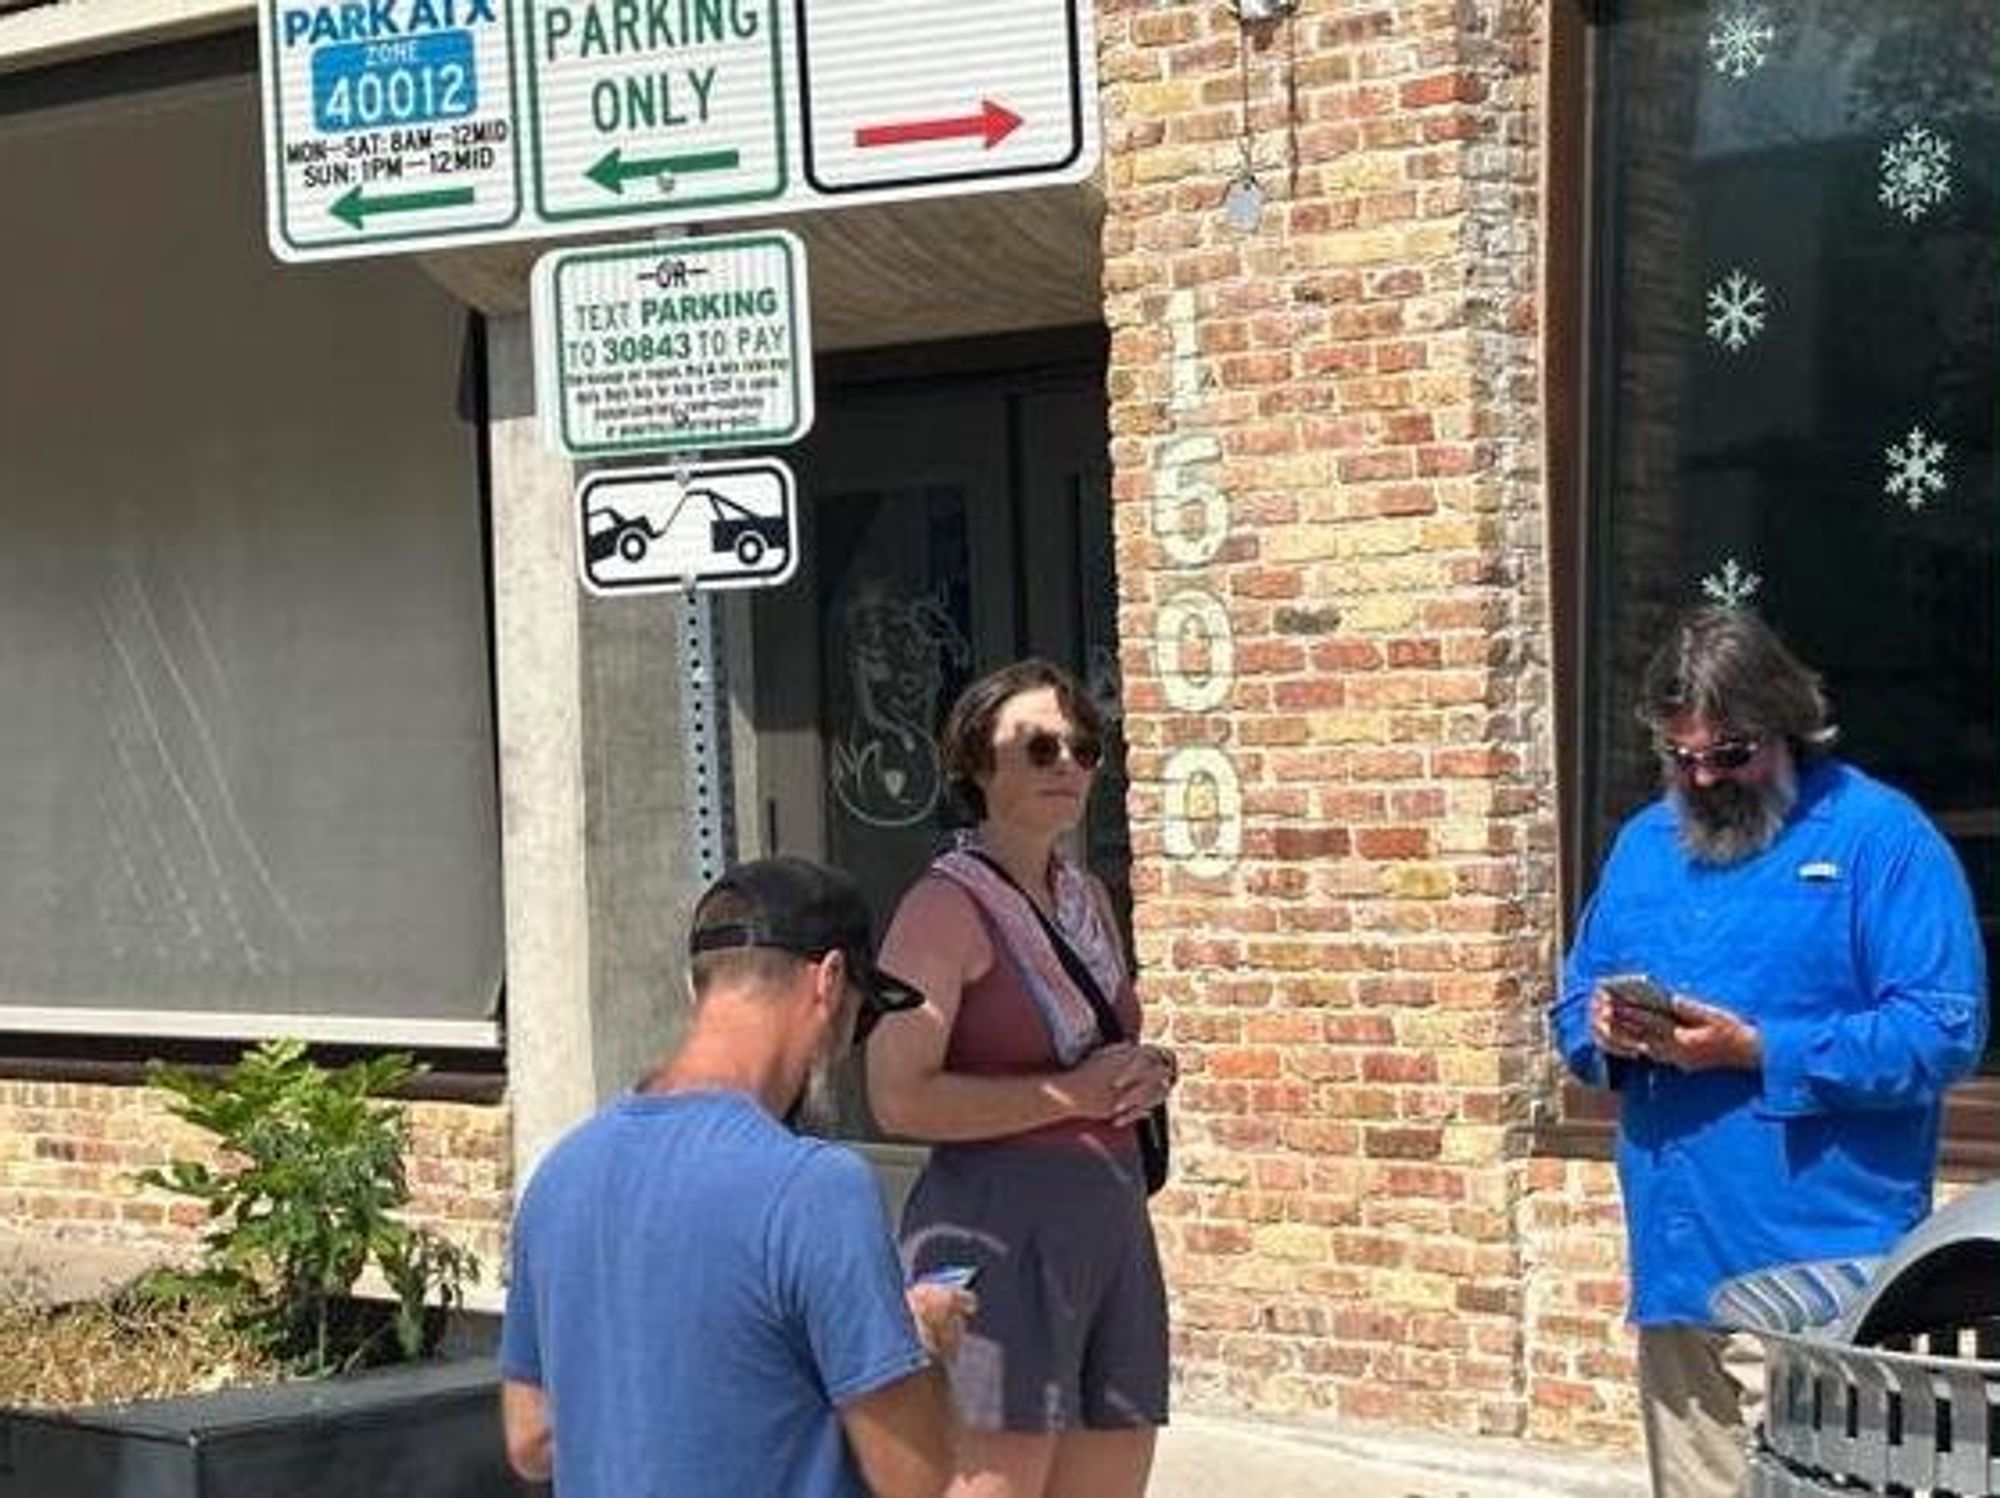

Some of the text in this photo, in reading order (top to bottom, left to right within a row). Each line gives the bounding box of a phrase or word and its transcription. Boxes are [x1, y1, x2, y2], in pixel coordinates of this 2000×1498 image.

[284, 0, 399, 48] PARK
[545, 0, 757, 61] PARKING
[365, 41, 418, 67] ZONE
[325, 63, 467, 127] 40012
[591, 67, 716, 133] ONLY
[577, 287, 777, 331] TEXT PARKING
[567, 325, 786, 368] TO 30843 TO PAY
[1151, 288, 1241, 879] 1500
